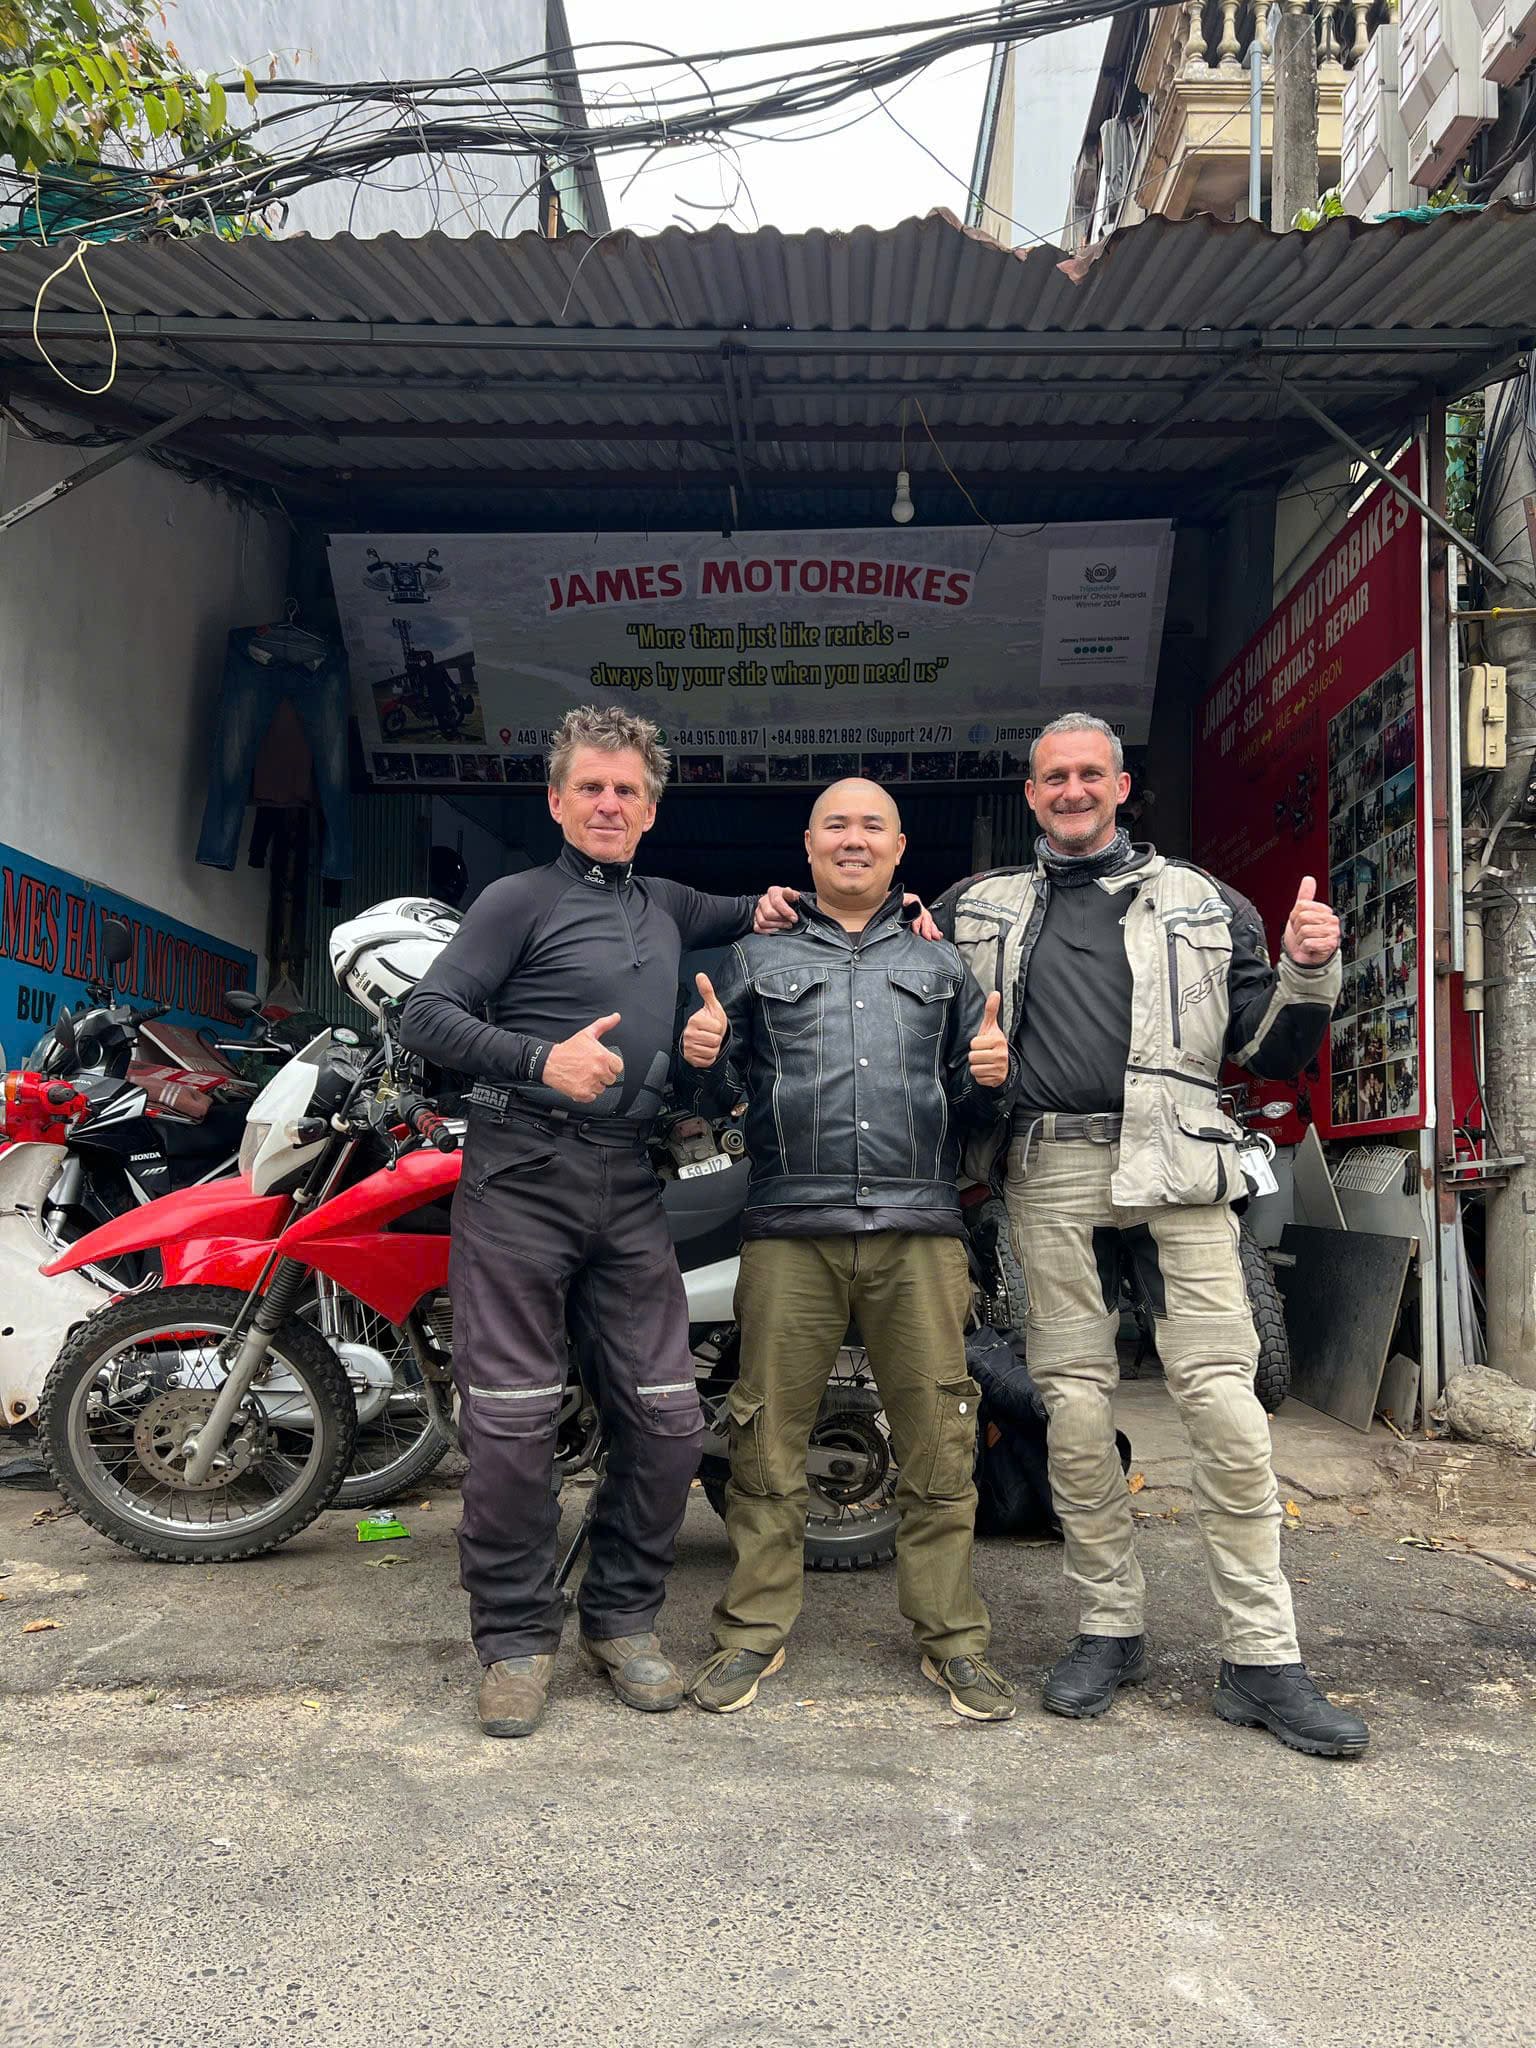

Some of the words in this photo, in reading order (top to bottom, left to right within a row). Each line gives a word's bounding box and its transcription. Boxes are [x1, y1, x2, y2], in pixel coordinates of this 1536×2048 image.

[550, 564, 682, 611] JAMES
[702, 559, 970, 606] MOTORBIKES
[1244, 613, 1287, 697] HANOI
[1290, 474, 1409, 646] MOTORBIKES
[691, 623, 734, 649] than
[737, 623, 776, 653] just
[780, 622, 820, 648] bike
[825, 620, 894, 647] rentals
[591, 662, 653, 691] always
[656, 661, 679, 691] by
[682, 666, 725, 691] your
[728, 661, 768, 687] side
[771, 660, 822, 685] when
[825, 664, 859, 689] you
[864, 658, 911, 684] need
[1243, 693, 1264, 735] SELL
[1272, 637, 1315, 707] RENTALS
[1325, 581, 1369, 652] REPAIR
[1308, 656, 1343, 703] SAIGON
[517, 730, 536, 745] 449
[867, 727, 915, 746] (Support
[919, 725, 952, 744] 24/7)
[17, 985, 57, 1026] BUY
[130, 1151, 161, 1162] HONDA
